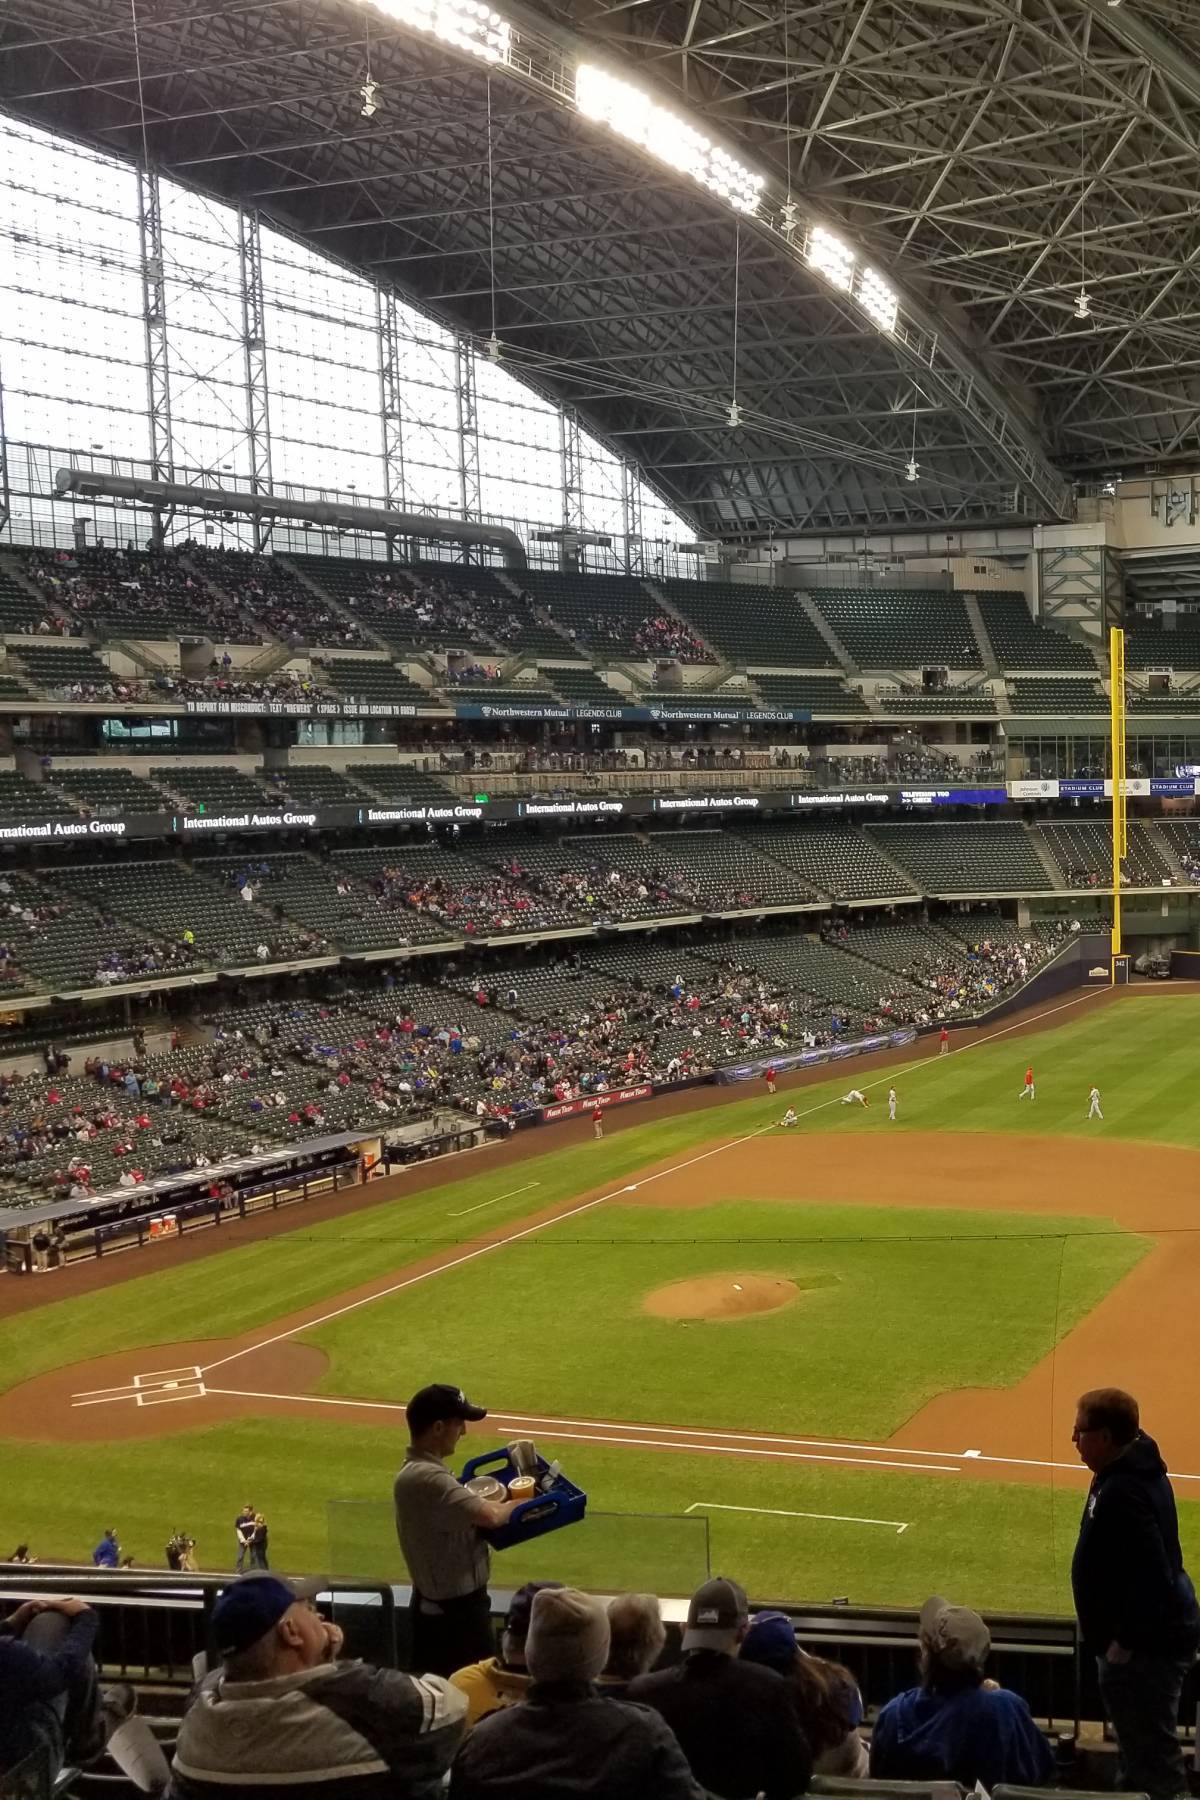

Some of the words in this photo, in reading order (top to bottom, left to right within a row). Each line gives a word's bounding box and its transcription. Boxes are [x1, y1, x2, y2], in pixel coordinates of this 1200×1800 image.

[491, 707, 542, 718] Northwestern
[543, 708, 570, 718] Mutual
[576, 708, 605, 719] LEGENDS
[606, 709, 623, 719] CLUB
[660, 710, 712, 720] Northwestern
[713, 710, 739, 720] Mutual
[746, 711, 775, 720] LEGENDS
[776, 711, 794, 720] CLUB
[659, 797, 709, 808] International
[709, 796, 734, 807] Autos
[734, 796, 760, 808] Group
[797, 793, 844, 804] International
[844, 792, 866, 803] Autos
[865, 792, 889, 804] Group
[367, 806, 426, 820] International
[426, 805, 453, 818] Autos
[453, 805, 482, 818] Group
[525, 801, 575, 814] International
[575, 801, 599, 812] Autos
[599, 800, 623, 813] Group
[183, 814, 250, 830] International
[250, 812, 282, 826] Autos
[282, 811, 316, 827] Group
[53, 821, 89, 835] Autos
[90, 819, 125, 836] Group
